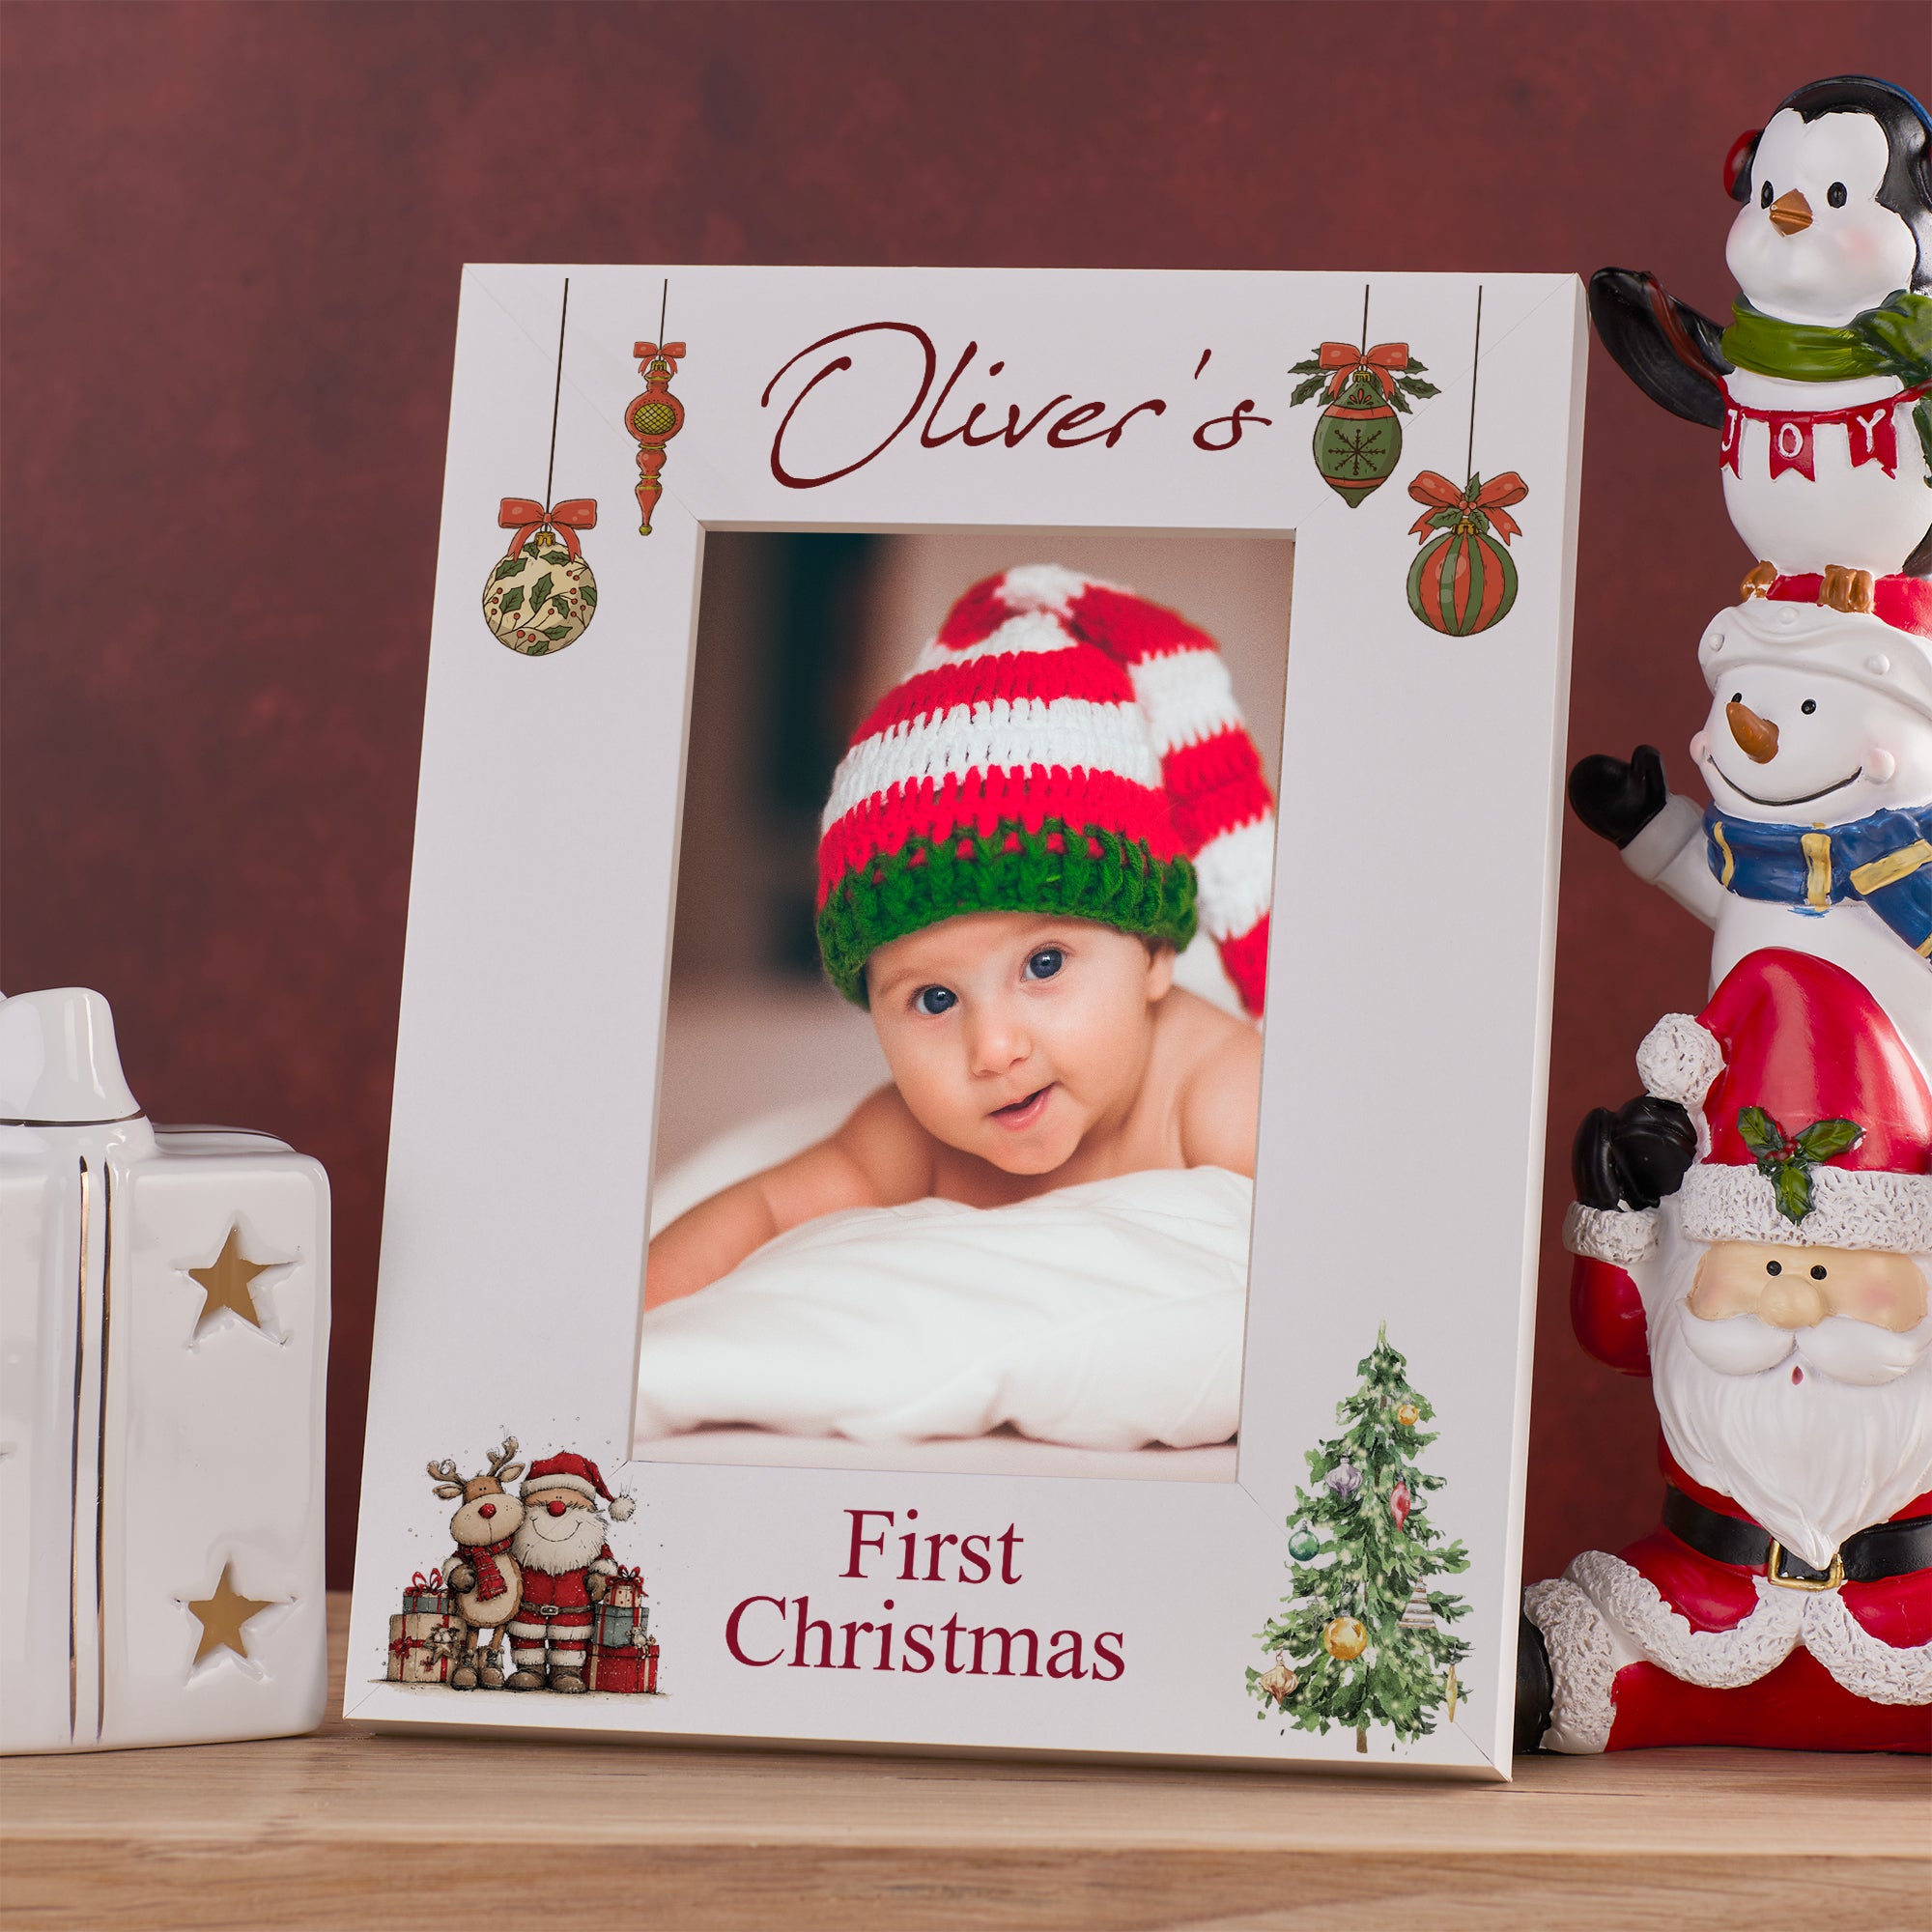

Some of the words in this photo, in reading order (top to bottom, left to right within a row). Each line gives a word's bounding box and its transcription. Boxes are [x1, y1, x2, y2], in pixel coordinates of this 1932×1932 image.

[760, 321, 1272, 489] Oliver's
[1720, 408, 1887, 458] JOY
[838, 1508, 1024, 1585] First
[724, 1595, 1125, 1682] Christmas
